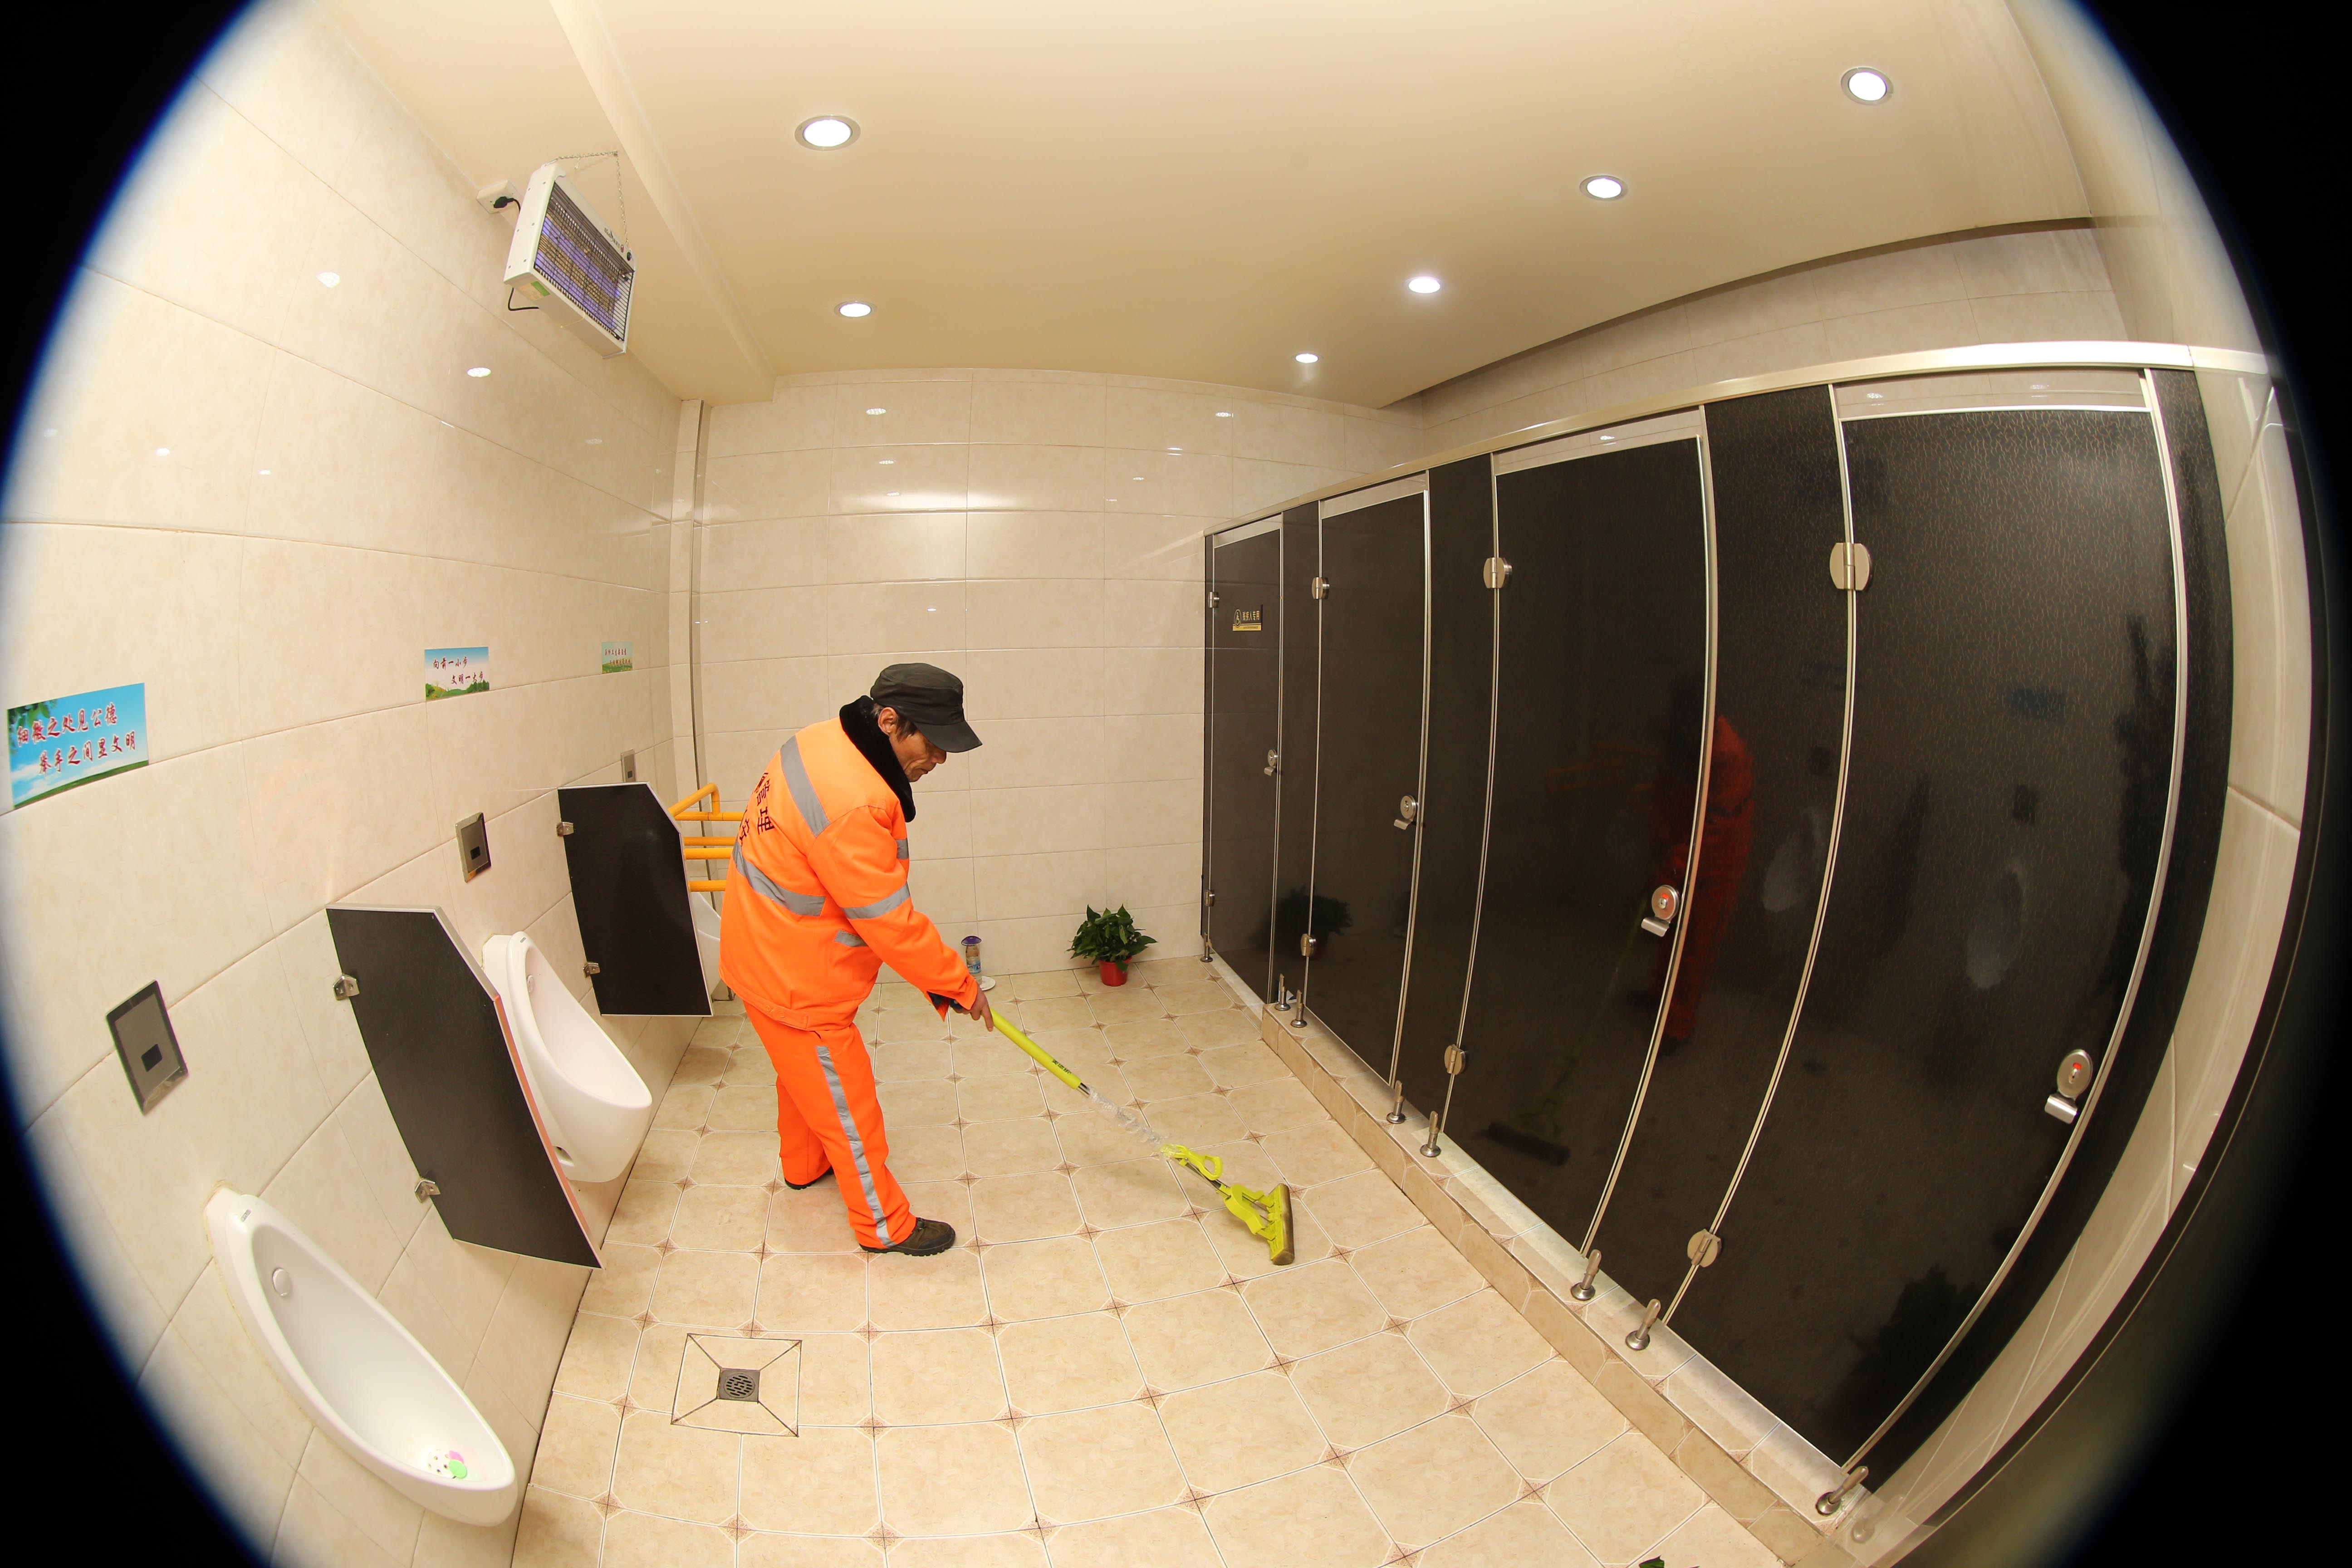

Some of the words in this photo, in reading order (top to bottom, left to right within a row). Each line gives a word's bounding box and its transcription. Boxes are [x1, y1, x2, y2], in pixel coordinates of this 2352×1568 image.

[433, 656, 468, 670] 向前一小步
[451, 671, 484, 684] 文明一大步
[17, 702, 118, 747] 细微之处见公德
[39, 730, 136, 776] 举手之间显文明
